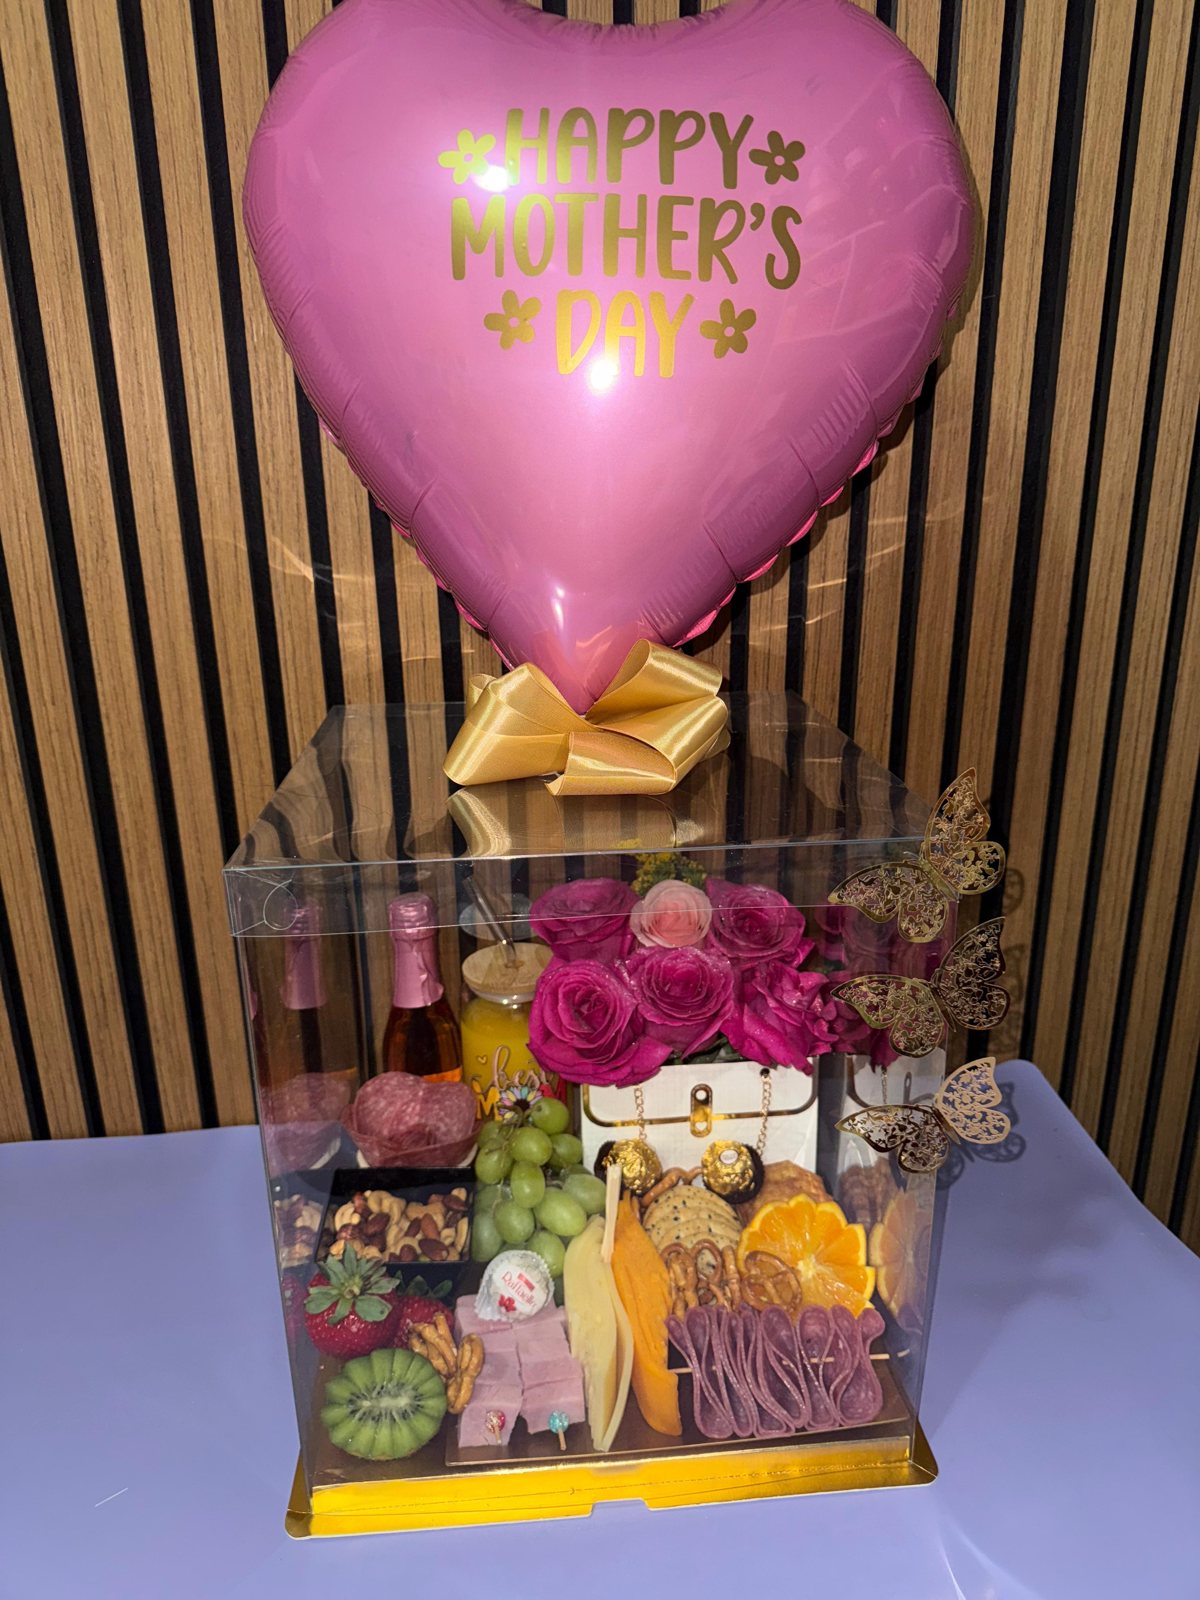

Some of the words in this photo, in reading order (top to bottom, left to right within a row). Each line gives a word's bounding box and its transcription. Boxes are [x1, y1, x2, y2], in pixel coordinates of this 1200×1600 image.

[504, 106, 754, 190] HAPPY
[450, 192, 802, 290] MOTHER'S
[555, 289, 695, 379] DAY
